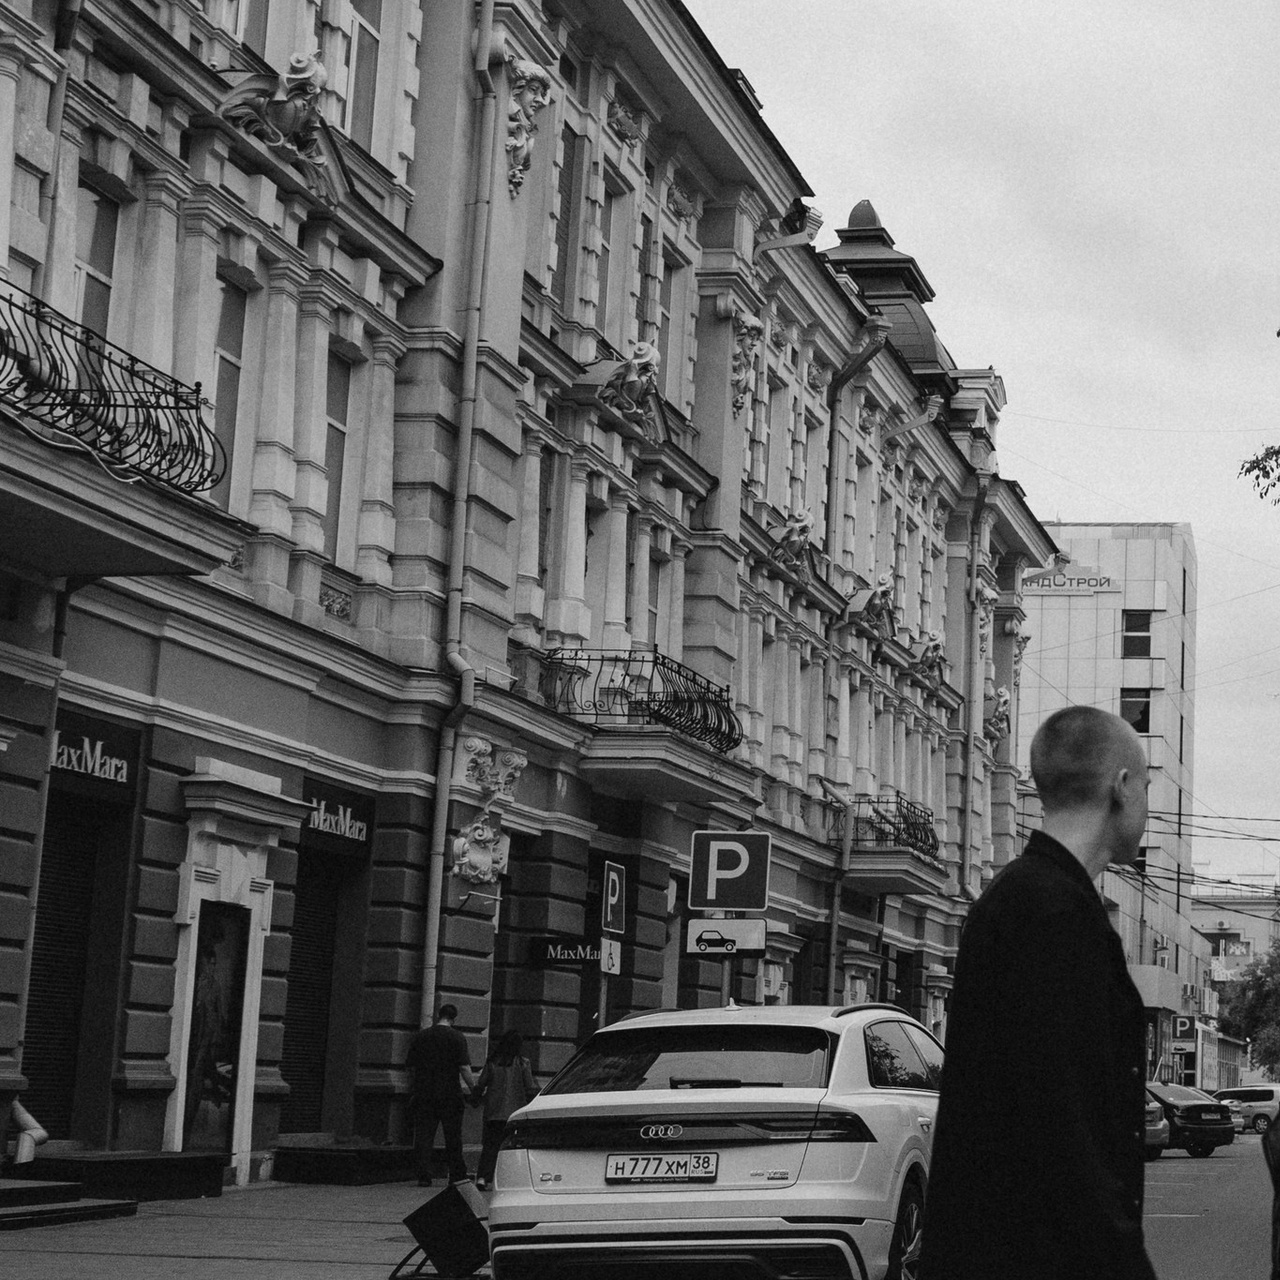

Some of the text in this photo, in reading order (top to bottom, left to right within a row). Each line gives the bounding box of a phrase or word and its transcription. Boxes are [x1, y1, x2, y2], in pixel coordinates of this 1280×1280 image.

[707, 841, 749, 900] P
[608, 871, 619, 922] P
[1177, 1018, 1190, 1038] P
[692, 1156, 710, 1169] 38
